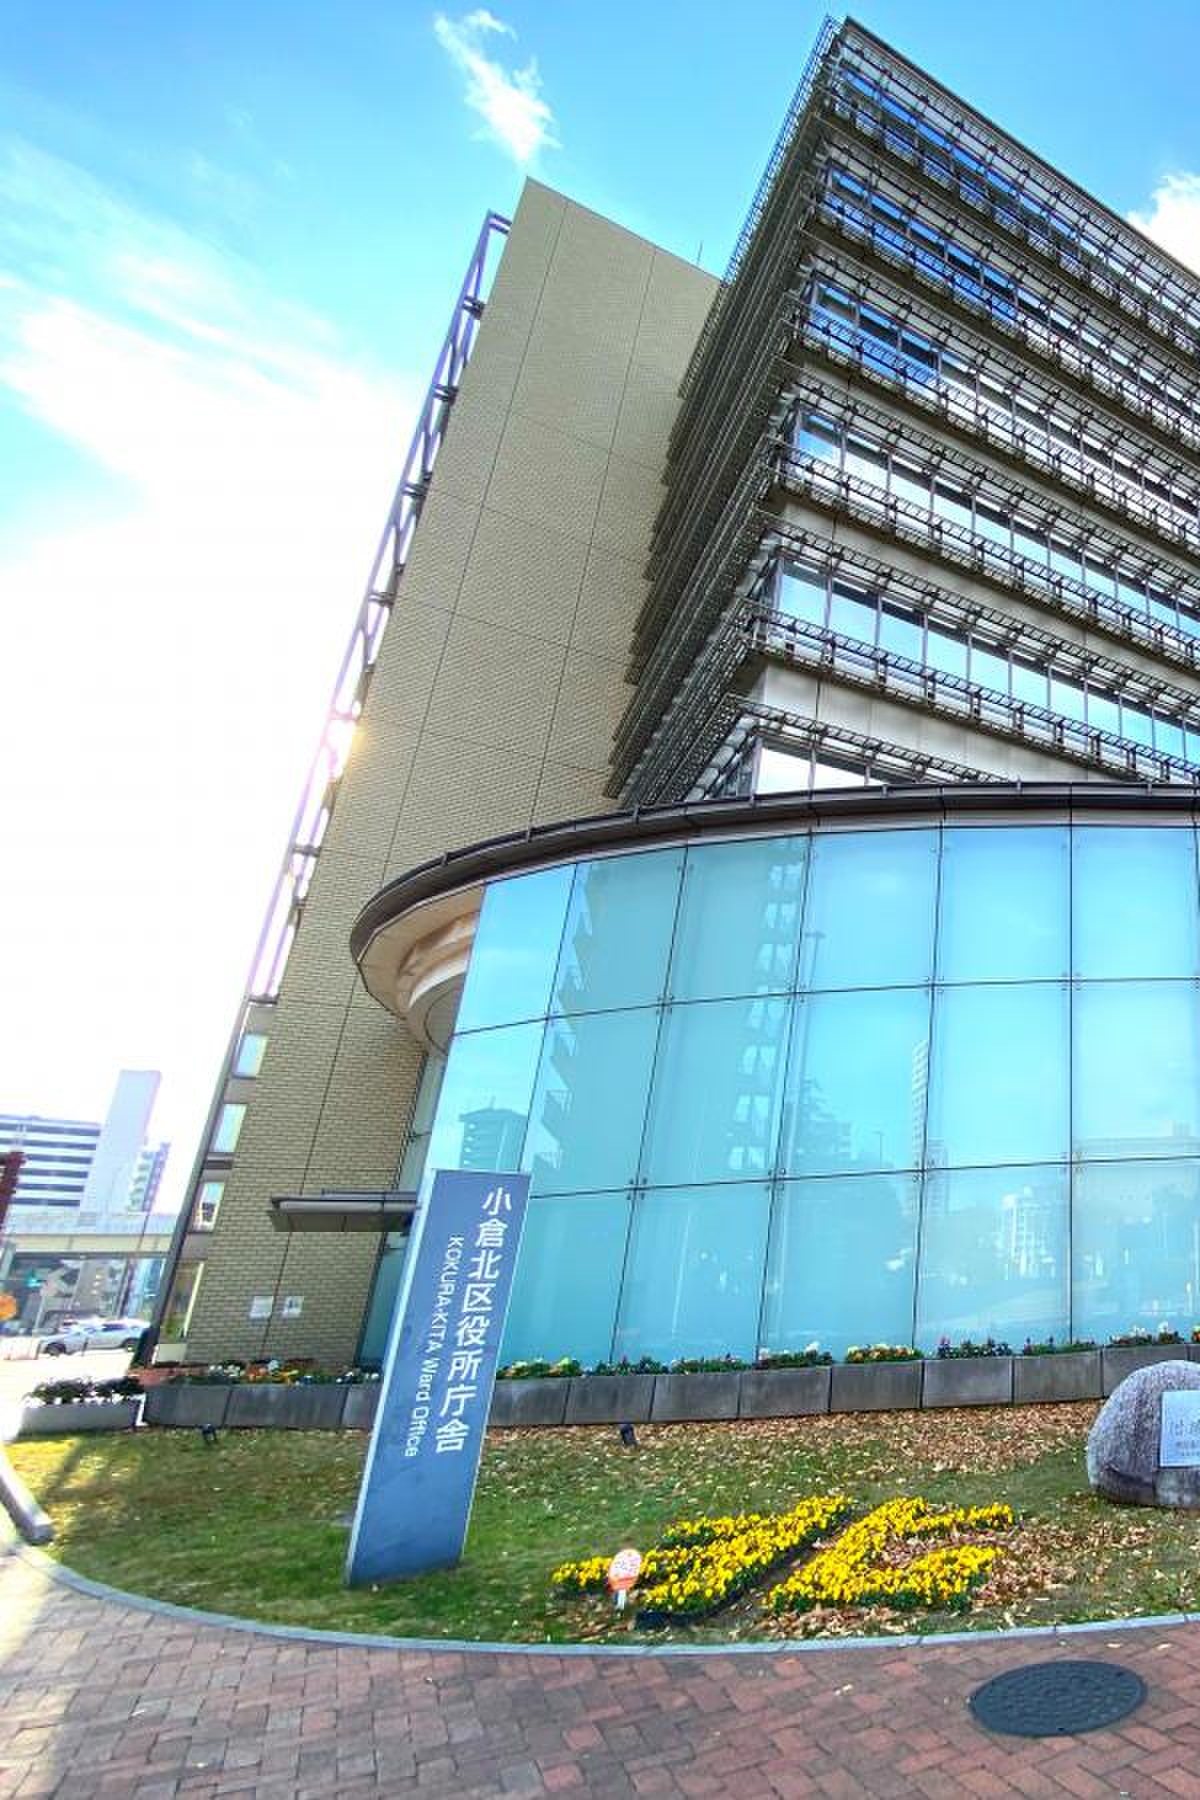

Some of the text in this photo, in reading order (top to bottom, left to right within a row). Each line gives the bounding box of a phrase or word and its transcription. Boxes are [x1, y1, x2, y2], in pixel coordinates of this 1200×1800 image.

[436, 1186, 512, 1453] 小倉北区役所庁舎
[416, 1358, 440, 1402] Ward
[404, 1406, 430, 1457] Office
